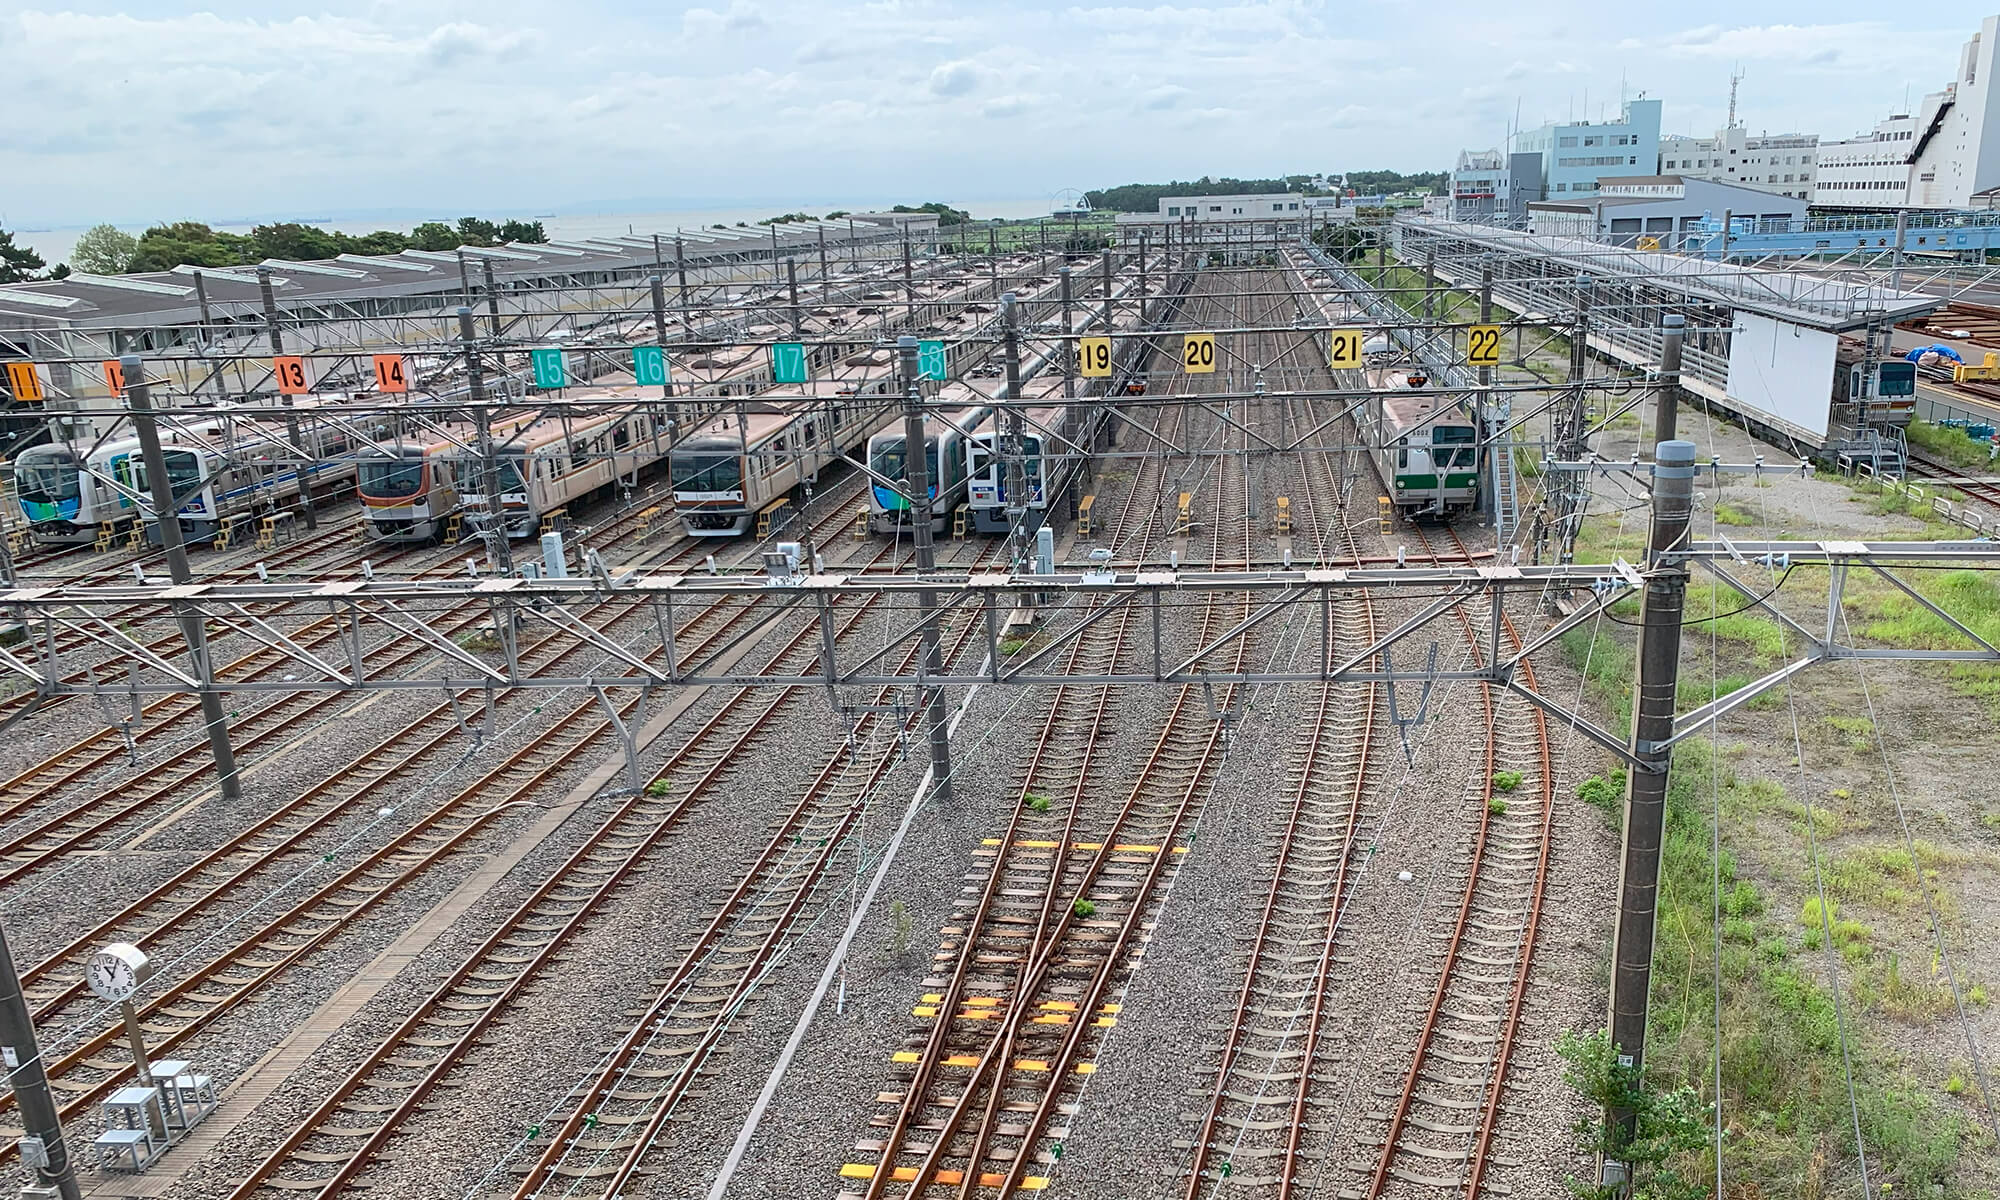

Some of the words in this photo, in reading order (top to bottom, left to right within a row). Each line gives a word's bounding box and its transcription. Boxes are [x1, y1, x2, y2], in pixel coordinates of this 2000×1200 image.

[1086, 344, 1109, 370] 19
[1186, 340, 1213, 366] 20
[1333, 336, 1357, 361] 21
[1469, 329, 1499, 361] 22
[279, 363, 304, 387] 13
[379, 361, 403, 386] 14
[537, 353, 562, 384] 15
[638, 351, 662, 384] 16
[778, 347, 799, 379] 17
[13, 367, 38, 397] 11
[91, 972, 99, 980] 9
[127, 972, 134, 980] 3
[105, 985, 111, 994] 7
[113, 987, 121, 996] 6
[121, 985, 129, 994] 5
